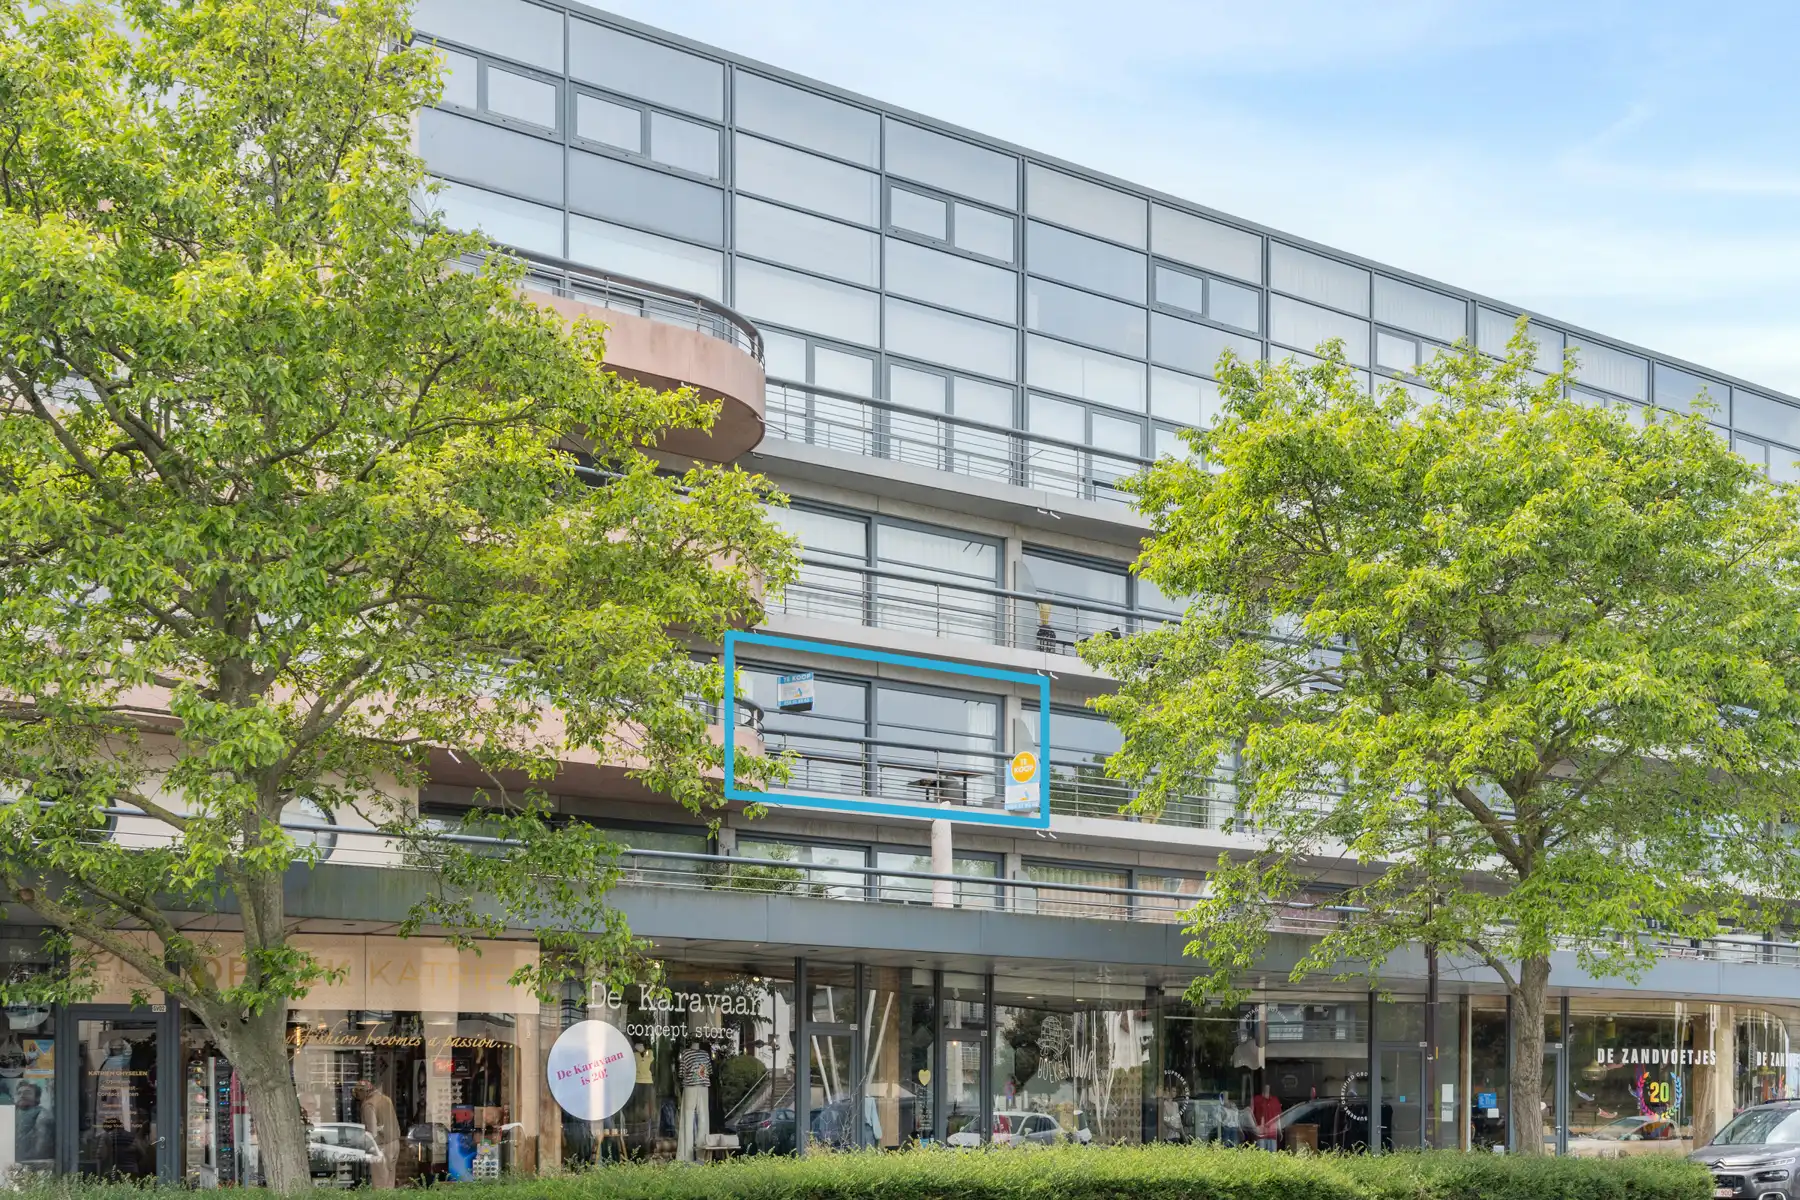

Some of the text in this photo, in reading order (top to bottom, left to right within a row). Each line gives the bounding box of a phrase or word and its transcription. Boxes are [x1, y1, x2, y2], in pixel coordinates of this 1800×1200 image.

[792, 673, 811, 681] KOOP
[1013, 765, 1034, 773] KOOP
[369, 957, 530, 992] KATRIE
[587, 980, 765, 1016] De Karavaan
[365, 1023, 423, 1047] becomes
[427, 1035, 438, 1047] a
[626, 1021, 735, 1041] concept store
[556, 1051, 624, 1081] De Karavaan
[1597, 1048, 1717, 1066] DE ZANDVOETJES
[1756, 1052, 1769, 1066] DE
[580, 1068, 608, 1086] is 20!
[1164, 1070, 1187, 1085] SUPREME
[1650, 1082, 1670, 1103] 20
